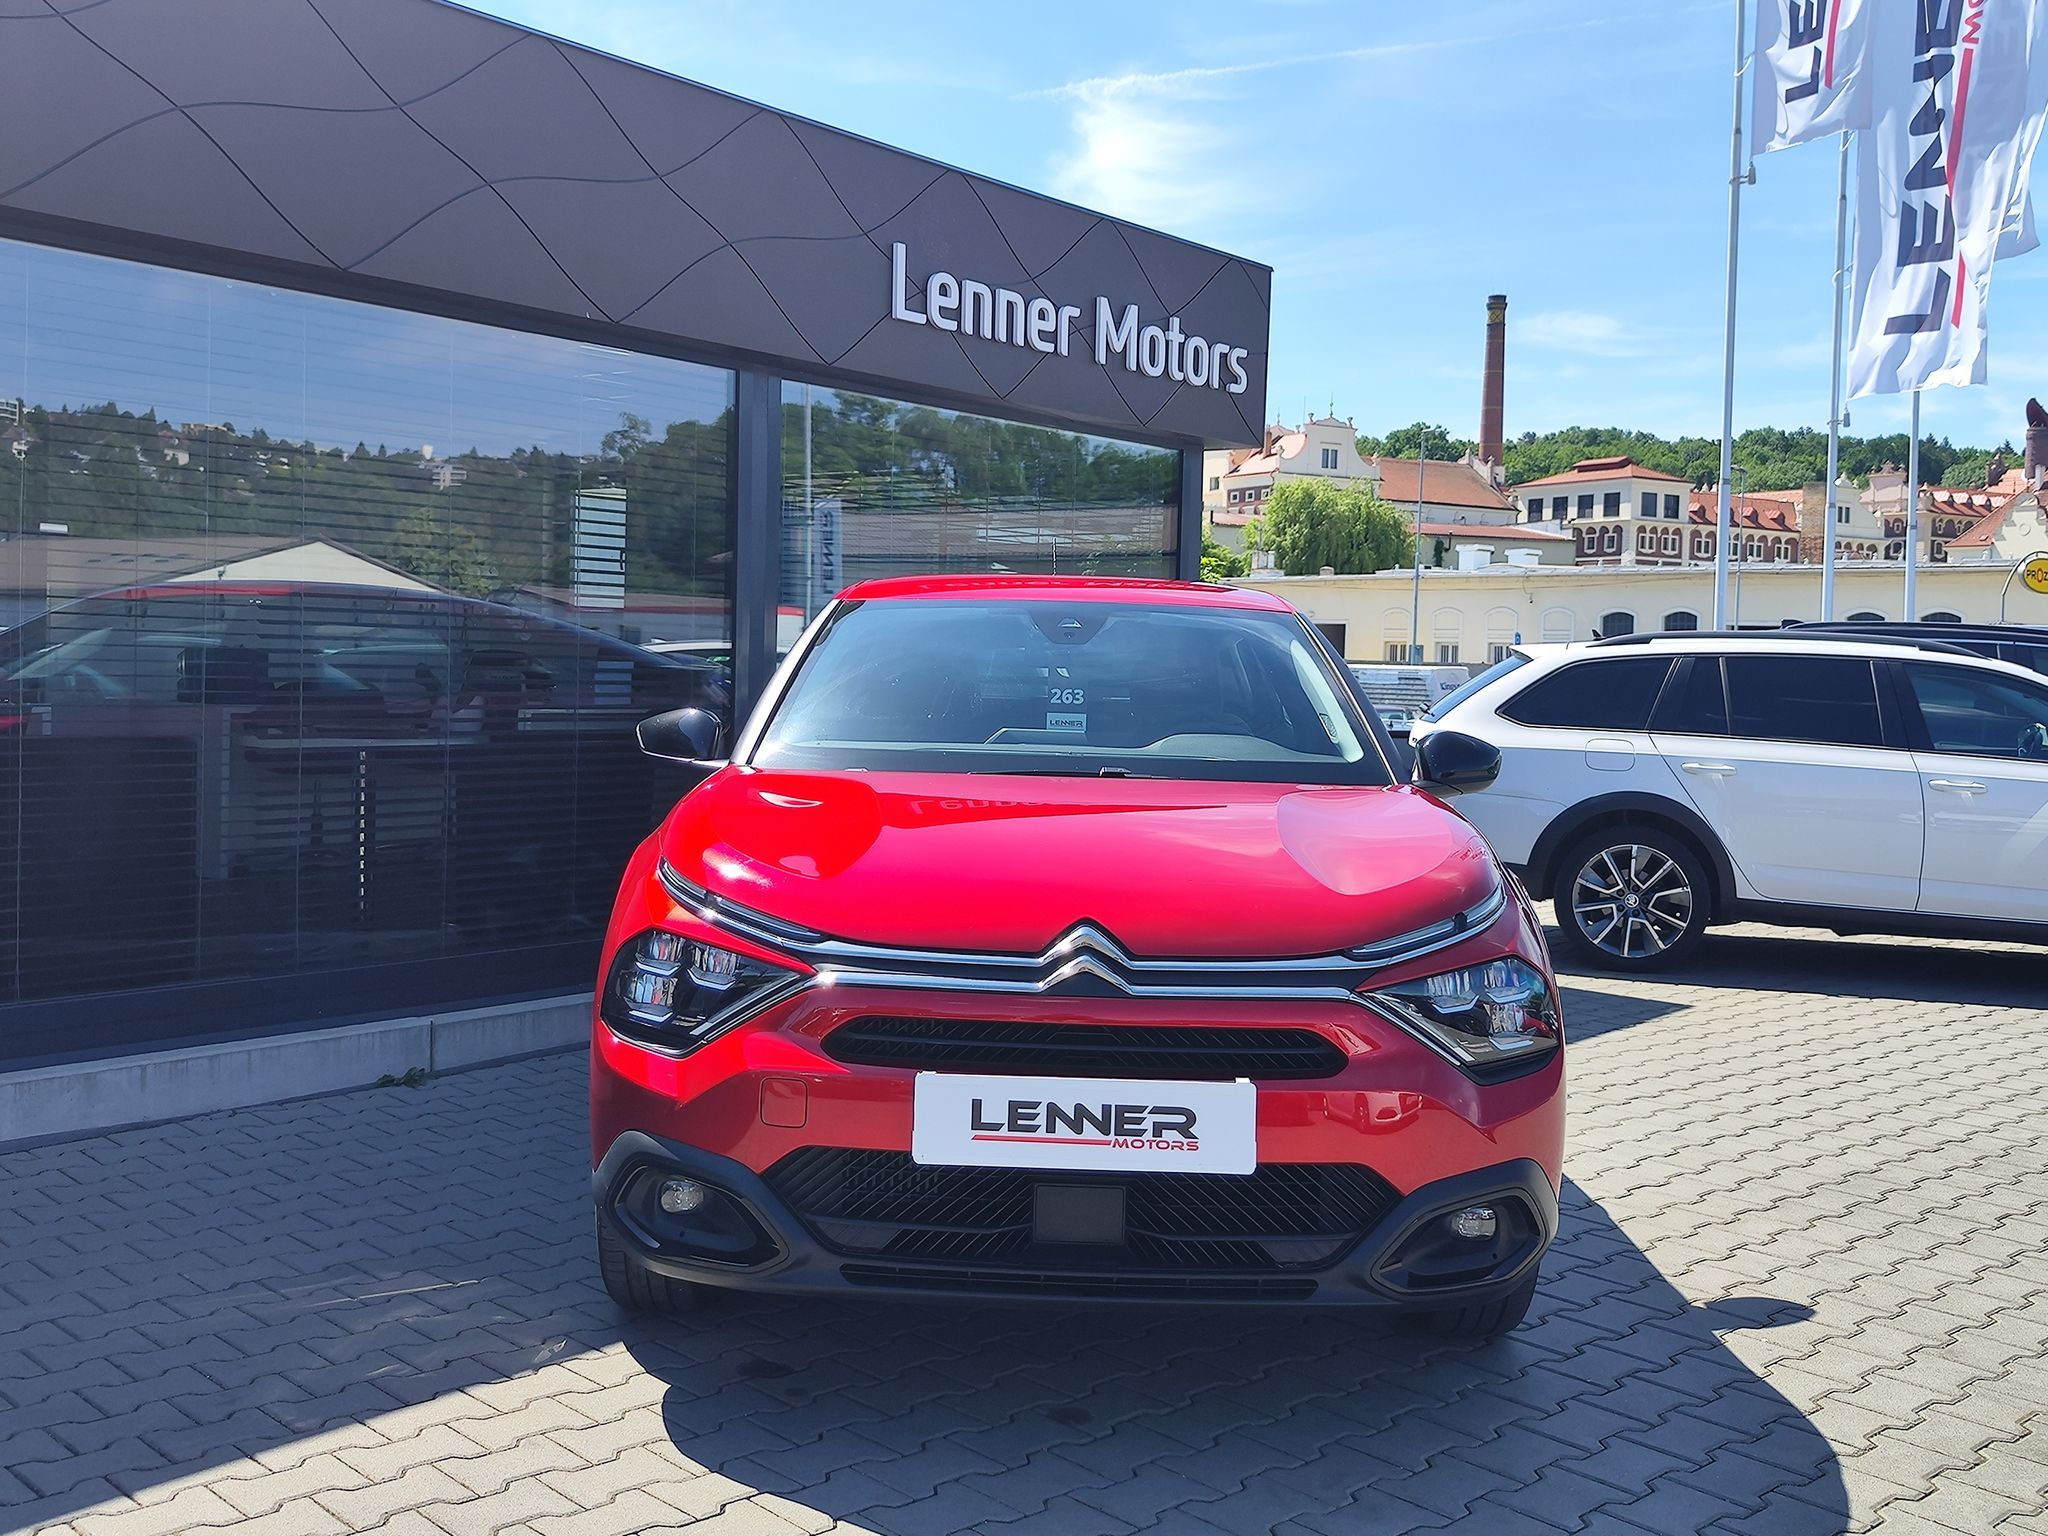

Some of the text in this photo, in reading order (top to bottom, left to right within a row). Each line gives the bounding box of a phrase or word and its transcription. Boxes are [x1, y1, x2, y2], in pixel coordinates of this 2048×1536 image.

[892, 242, 1249, 394] Lenner Motors
[1050, 688, 1084, 704] 263
[1049, 719, 1083, 728] LENNER
[971, 1098, 1199, 1139] LENNER
[1112, 1138, 1199, 1151] MOTORS
